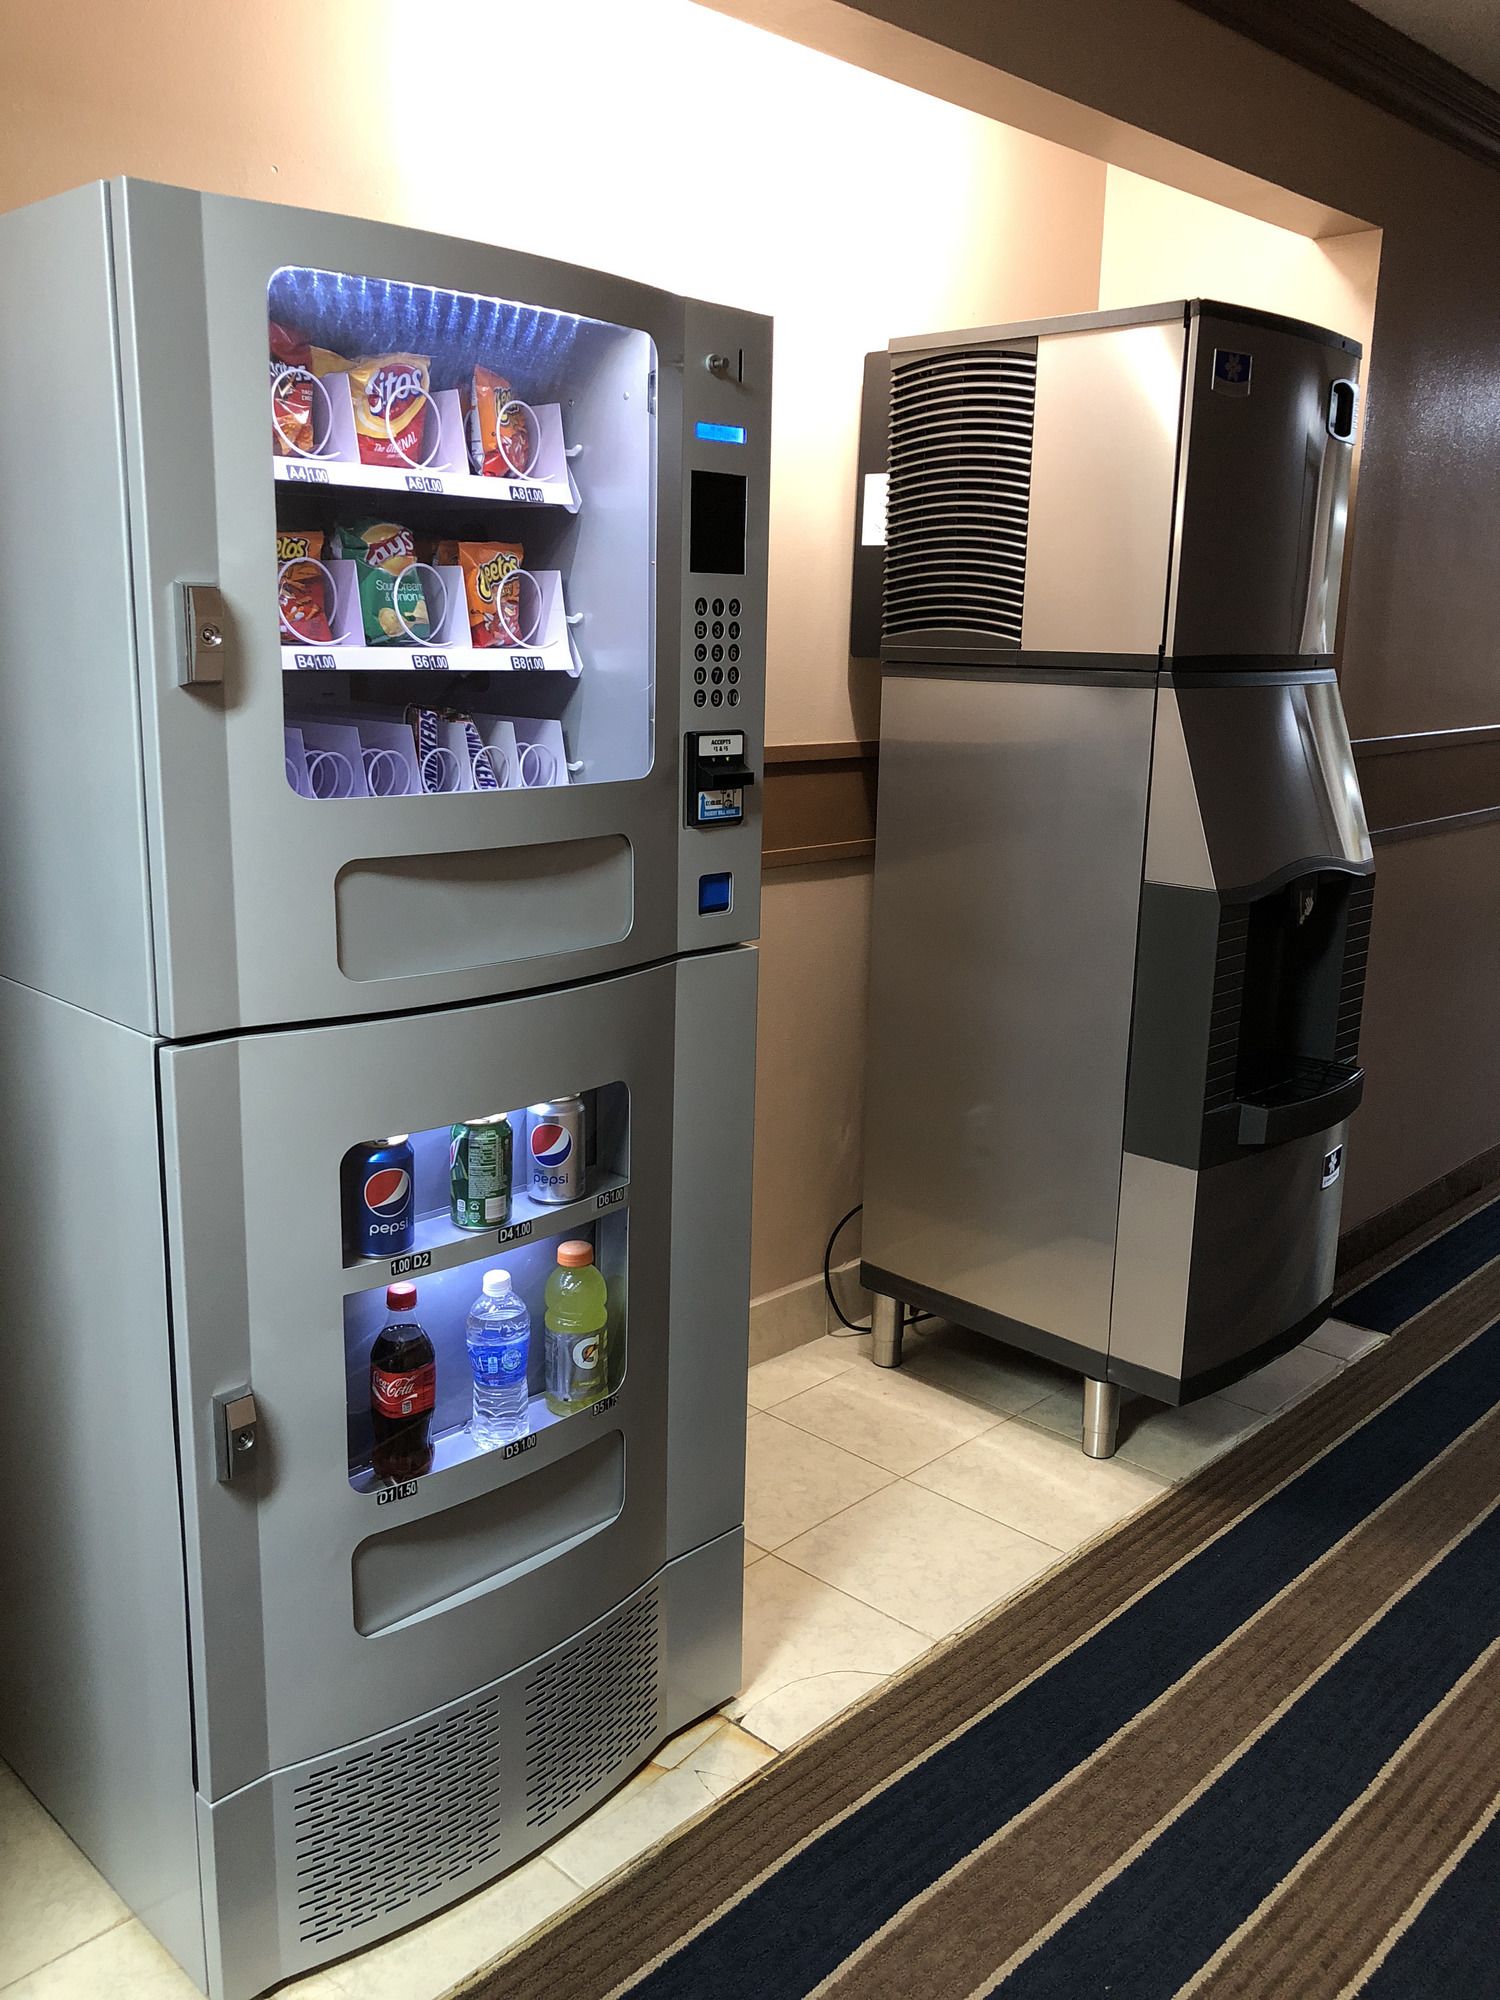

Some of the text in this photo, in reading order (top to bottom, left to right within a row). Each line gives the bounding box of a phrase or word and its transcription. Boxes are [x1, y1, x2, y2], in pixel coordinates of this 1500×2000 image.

[365, 369, 421, 413] Fitos
[386, 432, 418, 453] ORNAL
[290, 465, 328, 482] A4 1.00
[408, 476, 442, 491] A6 1.00
[512, 487, 543, 502] A8 1.00
[376, 580, 394, 591] Sour
[480, 556, 518, 599] Ceetos
[297, 655, 335, 669] B4 1.00
[413, 655, 448, 669] B6 1.00
[512, 656, 544, 670] B8 1.00
[420, 708, 437, 794] SNICKERS
[465, 723, 498, 790] SNICKER
[533, 1173, 569, 1187] pepsi
[598, 1188, 624, 1208] D6 1.00
[369, 1216, 409, 1236] pepsi
[500, 1221, 531, 1242] D4 1.00
[391, 1253, 430, 1275] 1.00 D2
[506, 1434, 536, 1458] D3 1.00
[379, 1481, 417, 1504] D1 1.50
